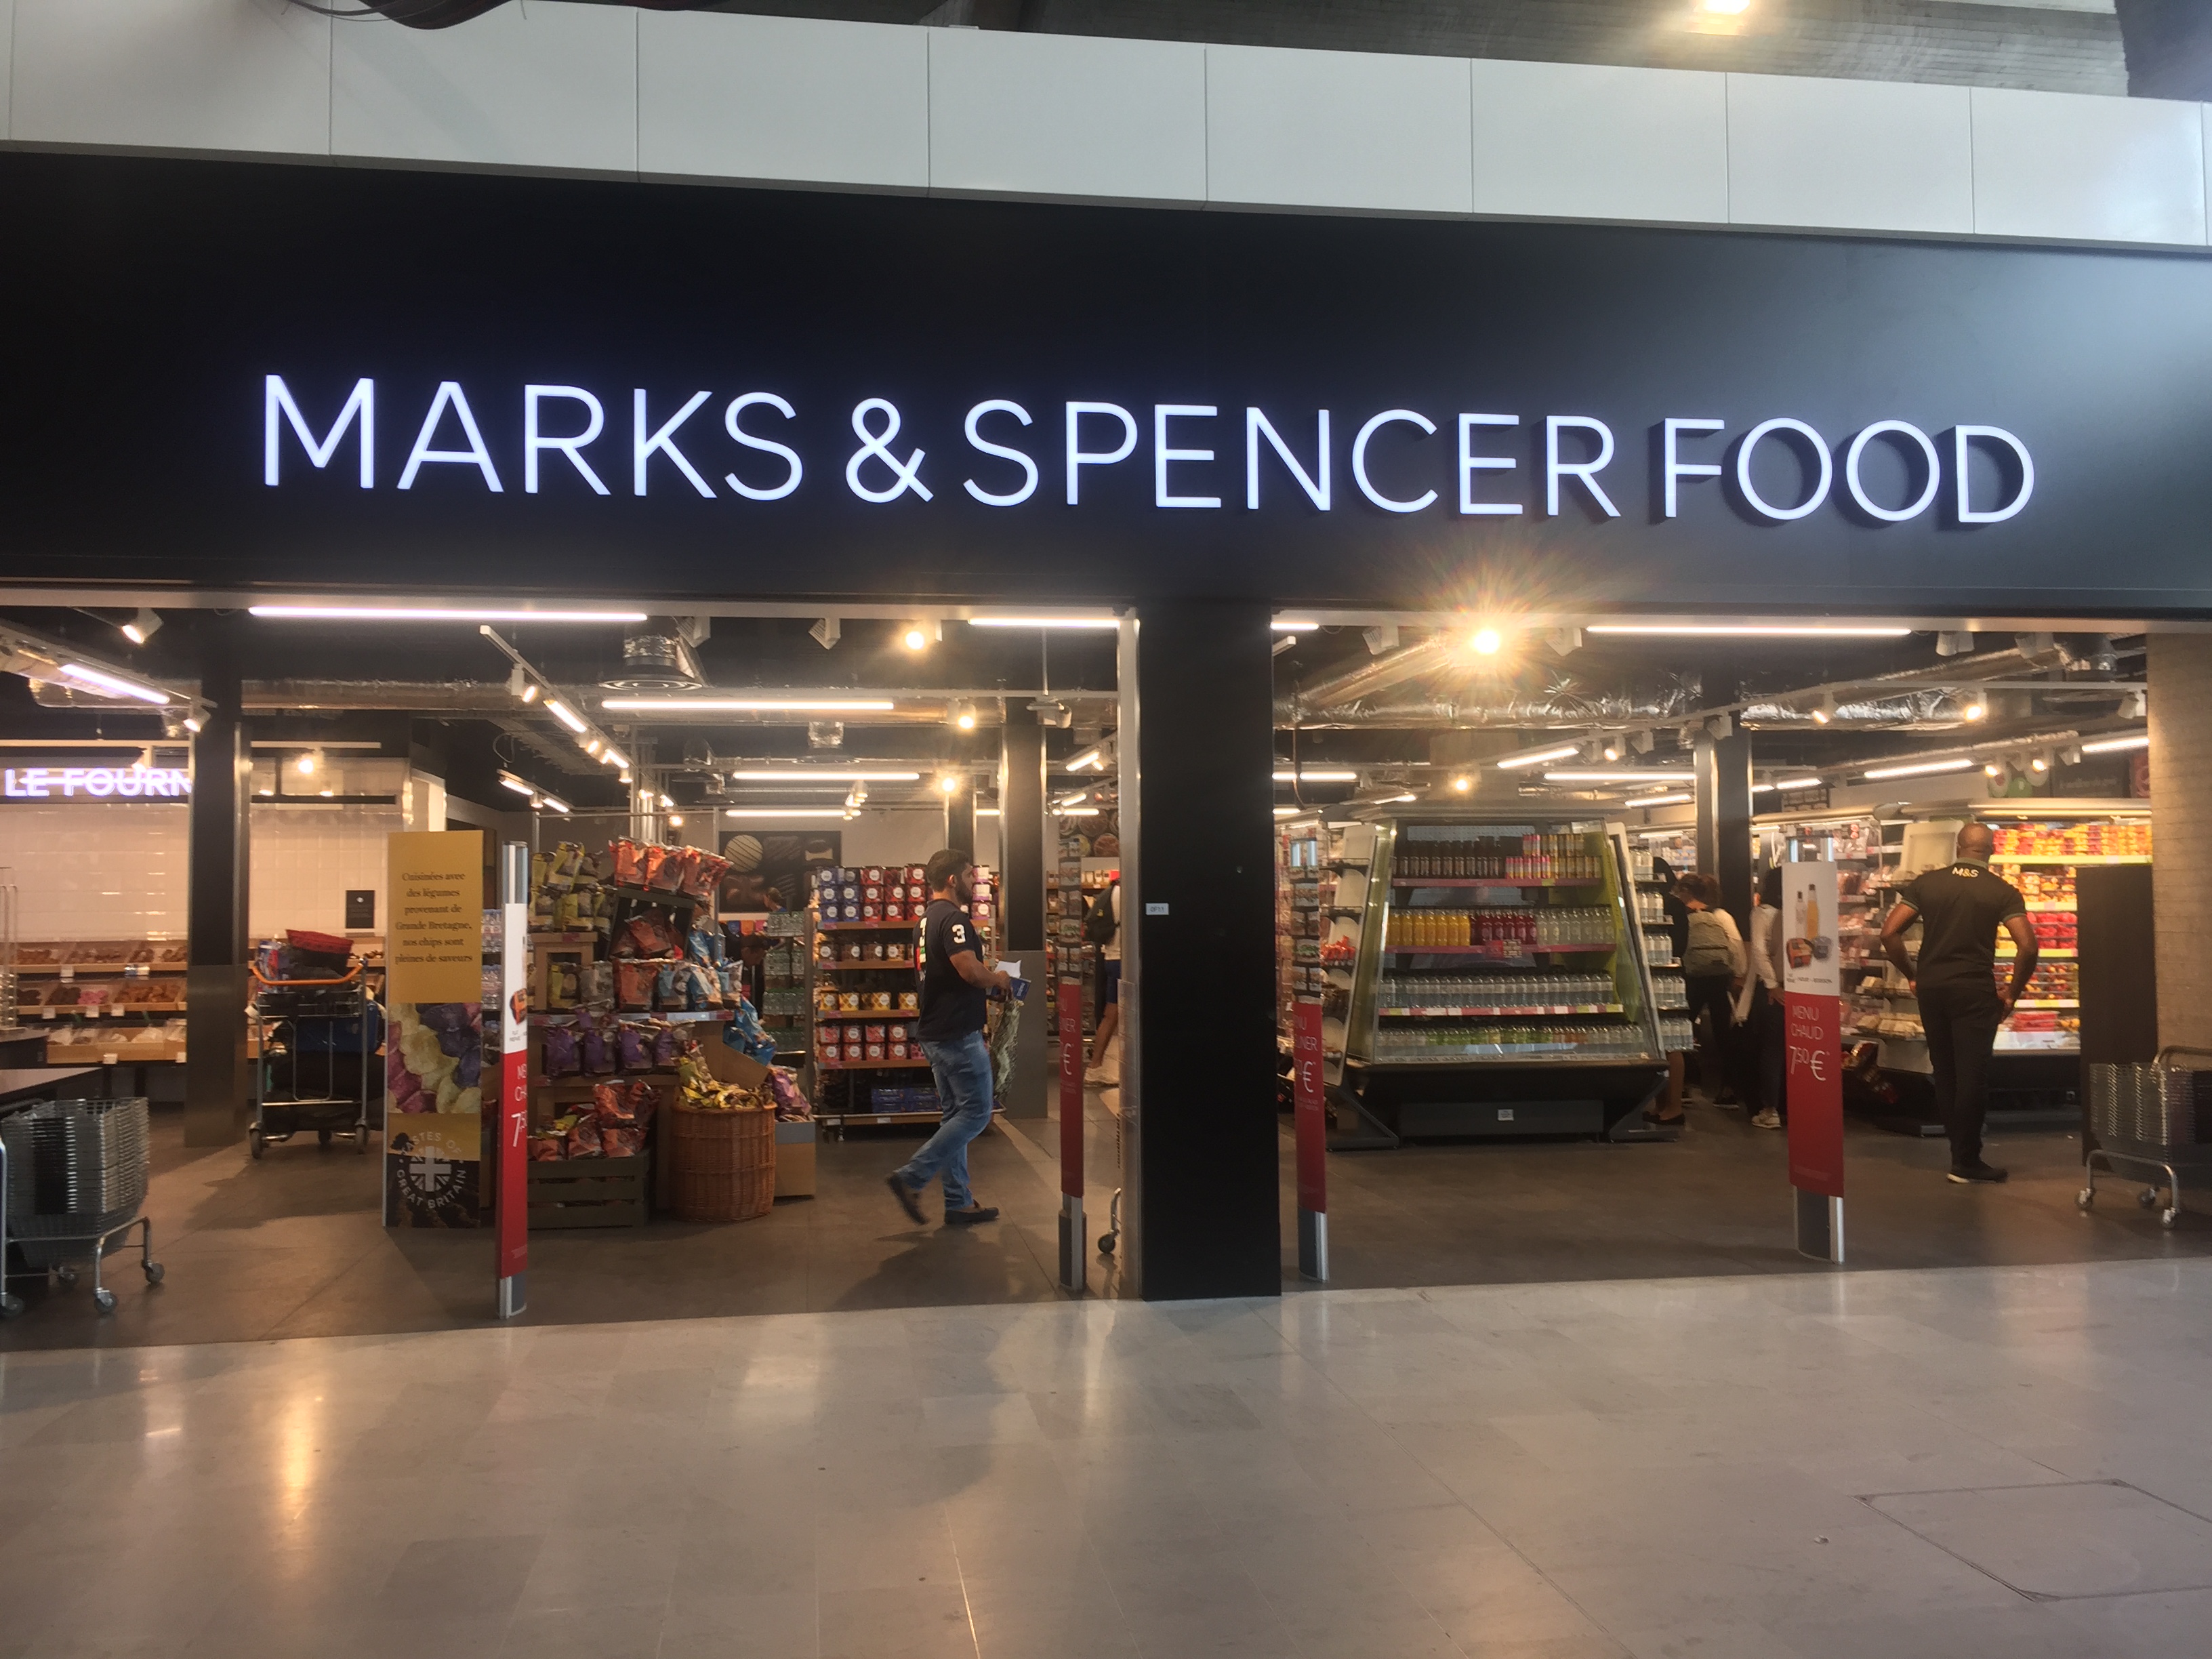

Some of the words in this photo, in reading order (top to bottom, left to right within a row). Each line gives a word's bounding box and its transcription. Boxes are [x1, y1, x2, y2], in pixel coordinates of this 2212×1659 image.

[264, 374, 804, 501] MARKS
[844, 396, 935, 504] &
[962, 398, 1622, 518] SPENCER
[1664, 417, 2035, 523] FOOD
[5, 768, 49, 797] LE
[1952, 867, 1979, 878] M&S
[407, 888, 421, 897] des
[405, 905, 449, 916] provenant
[451, 904, 462, 913] de
[395, 920, 426, 930] Grande
[951, 924, 966, 944] 3
[419, 937, 443, 949] chips
[395, 954, 424, 965] pleines
[426, 954, 437, 962] de
[396, 1169, 424, 1206] GREAT
[428, 1169, 467, 1209] BRITAIN
